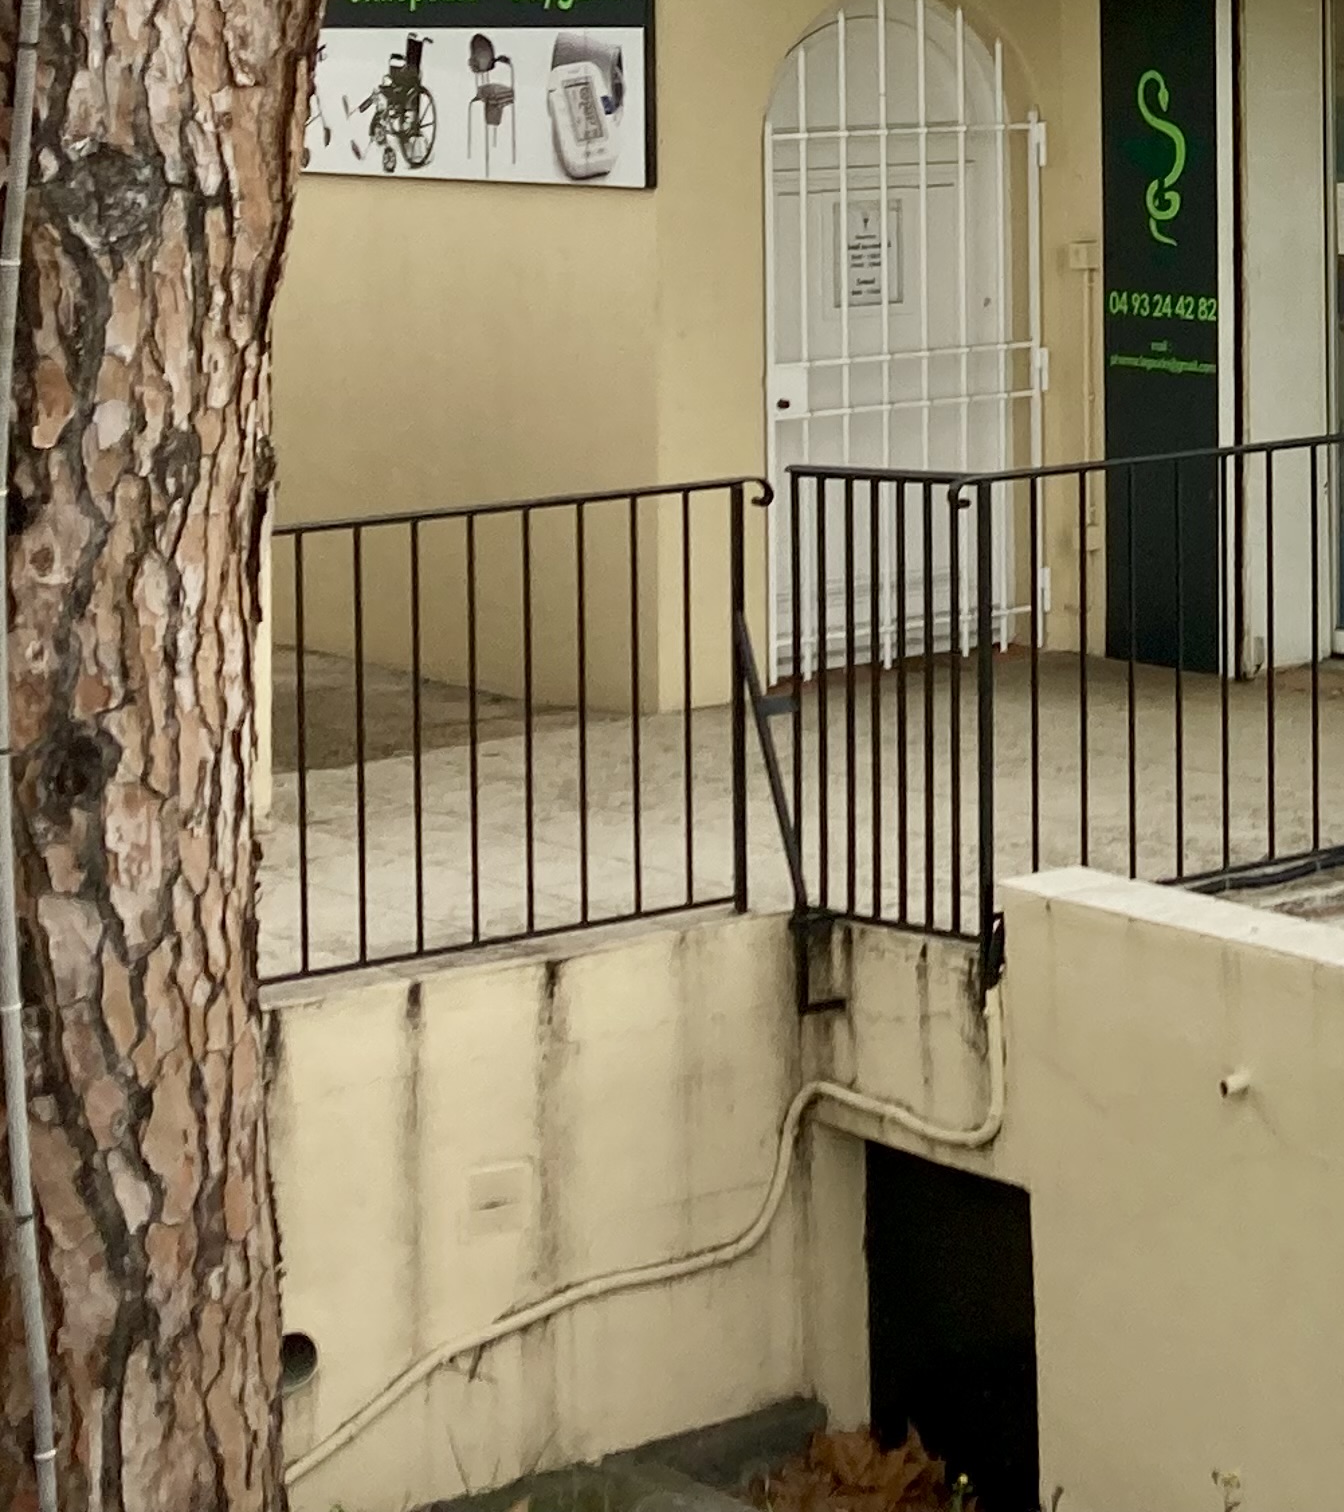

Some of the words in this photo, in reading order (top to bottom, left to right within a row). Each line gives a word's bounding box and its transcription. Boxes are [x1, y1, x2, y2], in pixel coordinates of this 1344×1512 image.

[1109, 291, 1129, 315] 04
[1131, 292, 1150, 317] 93
[1152, 294, 1172, 318] 24
[1175, 295, 1195, 320] 42
[1197, 297, 1217, 321] 82
